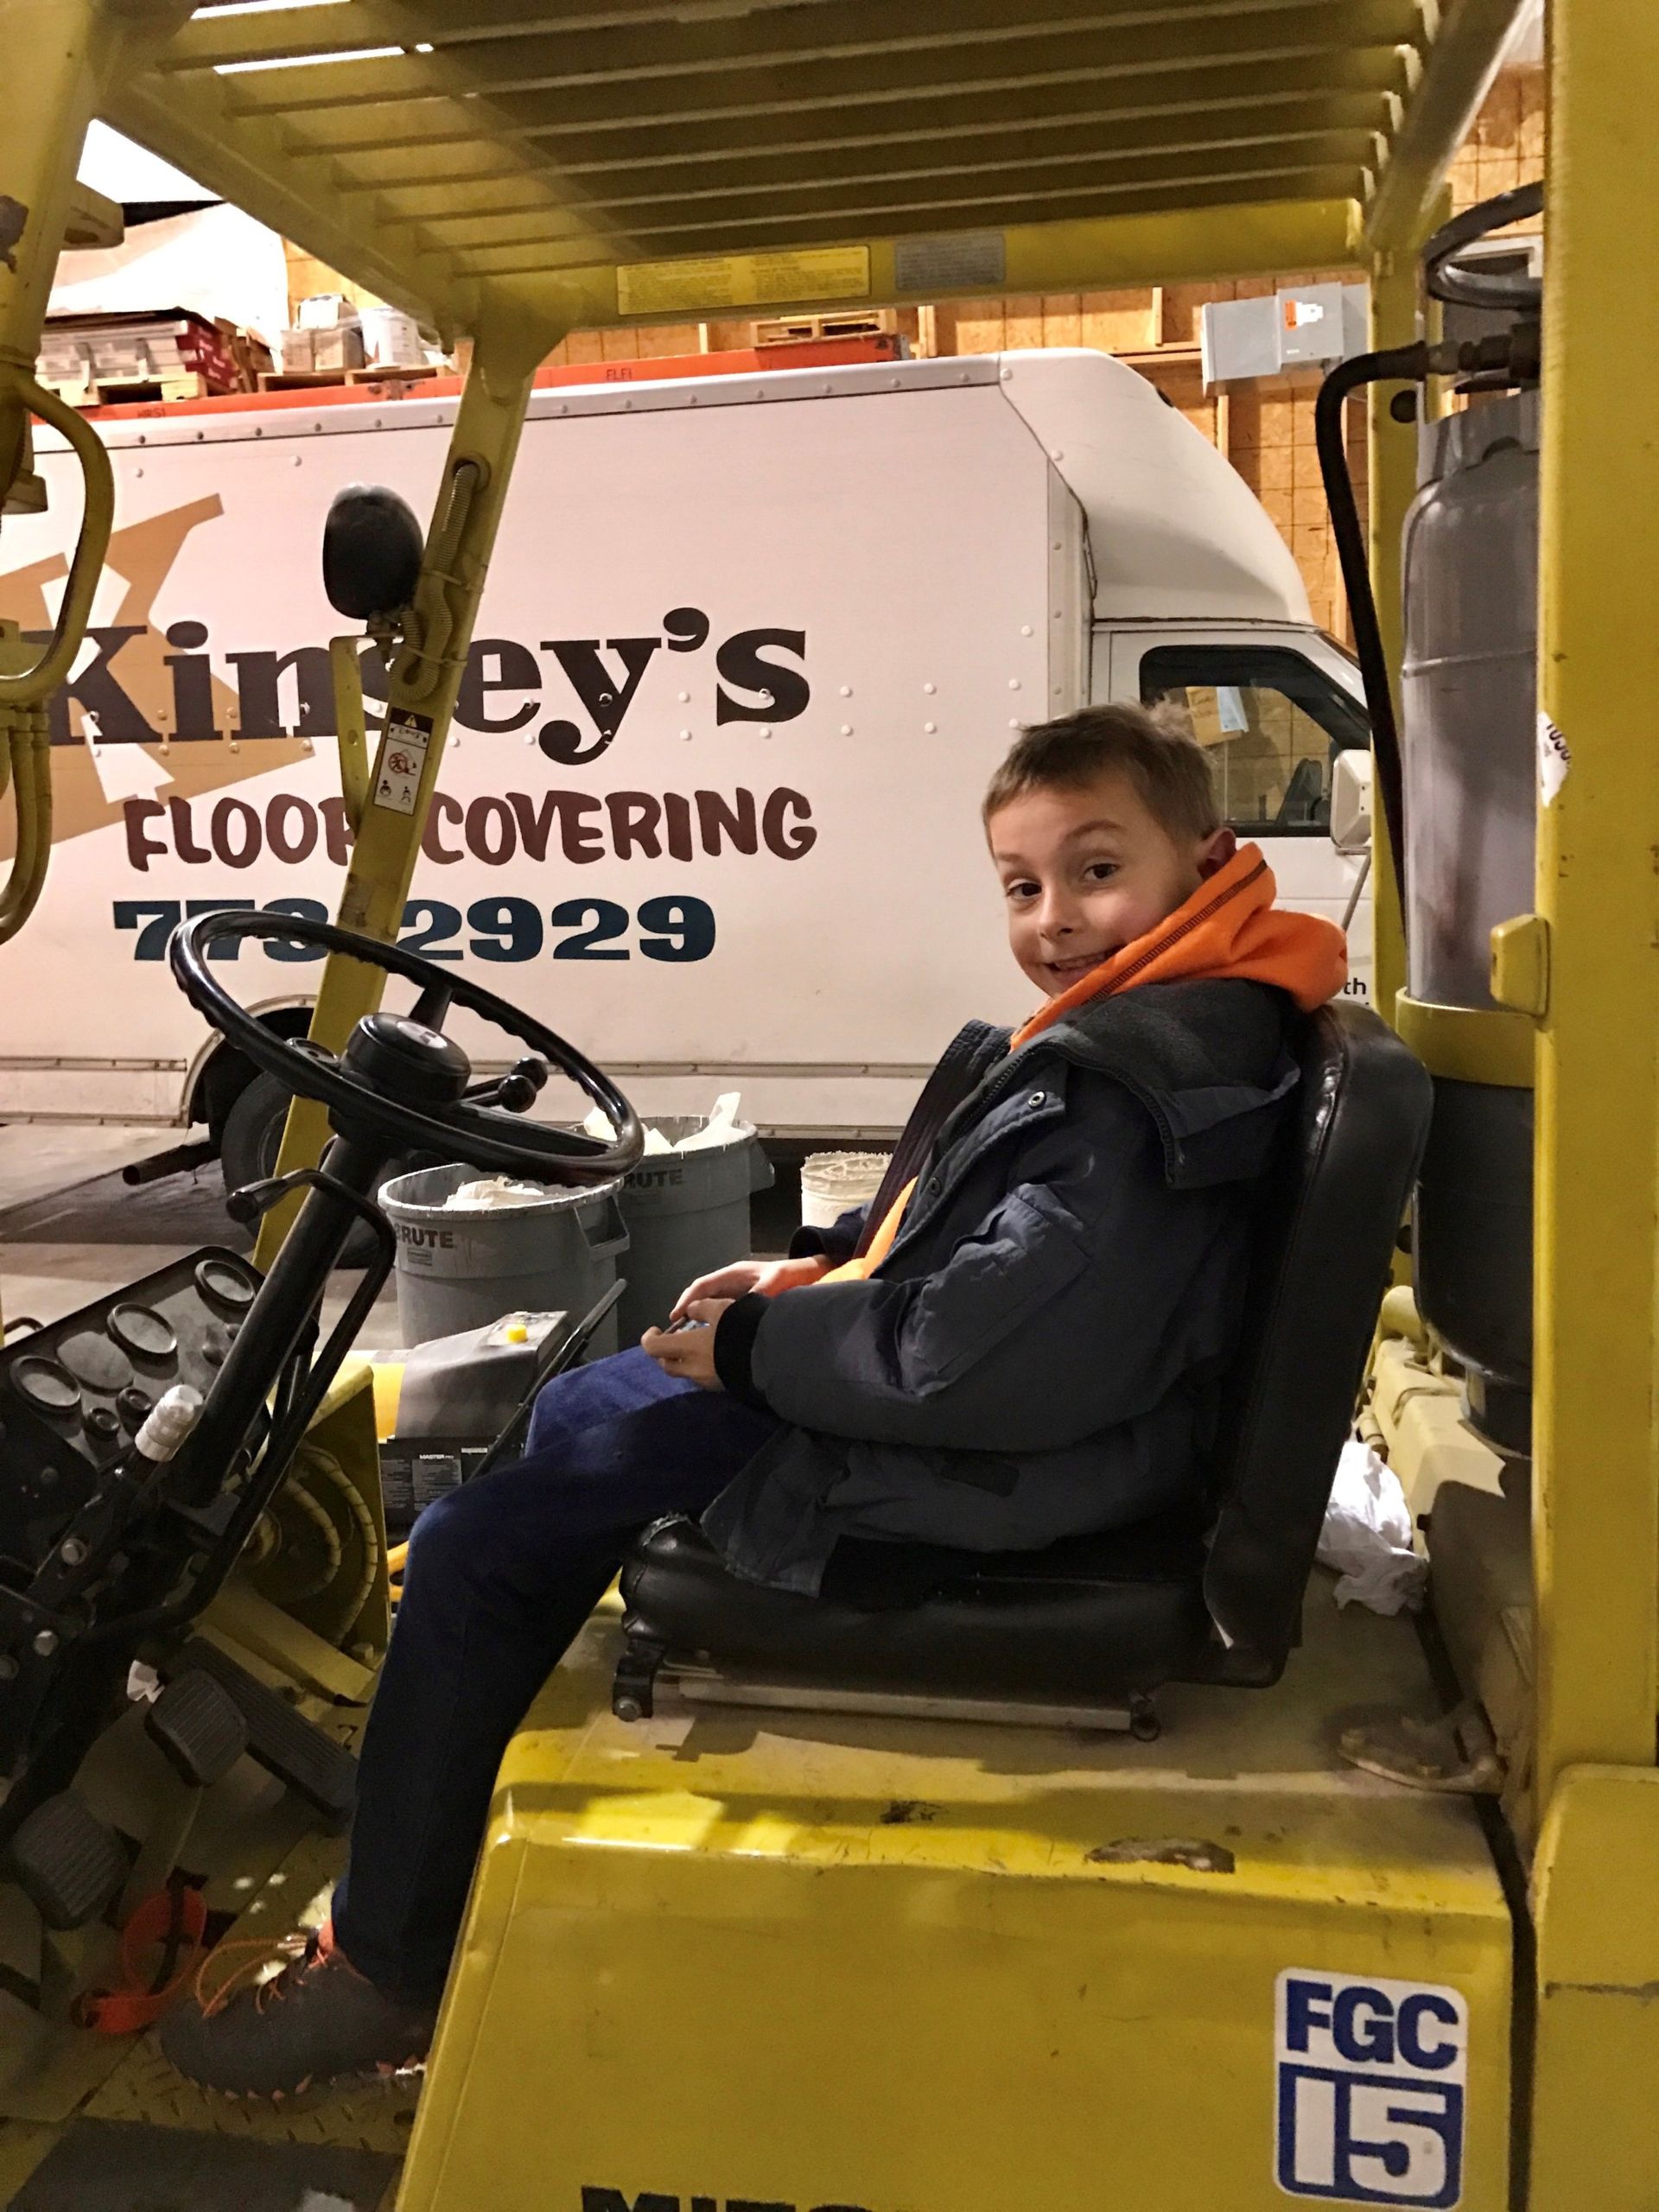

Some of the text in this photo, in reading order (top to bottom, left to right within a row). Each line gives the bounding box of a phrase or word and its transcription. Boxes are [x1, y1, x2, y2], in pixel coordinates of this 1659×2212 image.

[420, 787, 817, 866] COVERING
[395, 896, 716, 963] 2929
[623, 1168, 683, 1188] RUTE
[1287, 1978, 1459, 2070] FGC
[1294, 2075, 1446, 2197] 15
